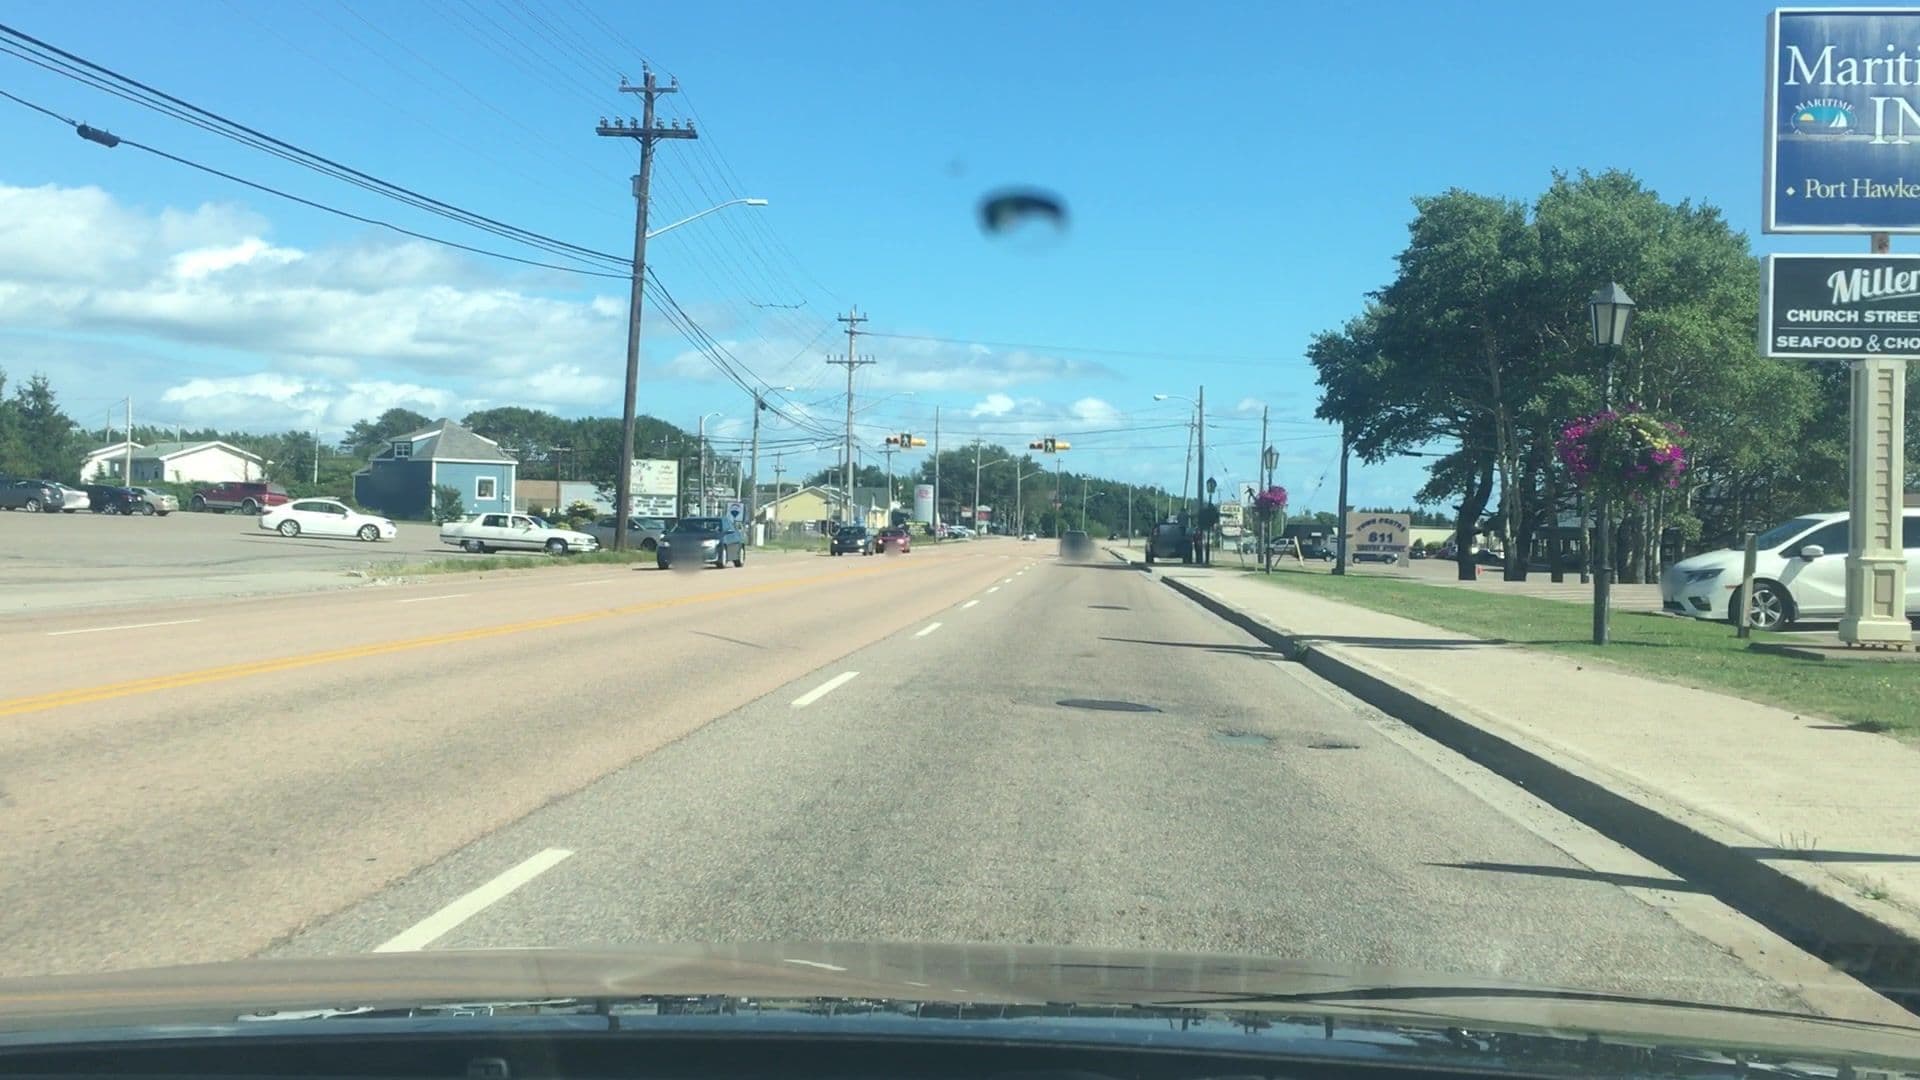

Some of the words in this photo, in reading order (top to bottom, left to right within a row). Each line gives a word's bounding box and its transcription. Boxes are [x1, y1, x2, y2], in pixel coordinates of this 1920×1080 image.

[1795, 98, 1855, 112] MARITIME
[1805, 179, 1847, 199] Port
[1853, 177, 1920, 199] Hawke
[1827, 267, 1920, 305] Miller
[1786, 309, 1859, 323] CHURCH
[1864, 310, 1920, 323] STREE
[1776, 335, 1863, 349] SEAFOOD
[1866, 334, 1881, 352] &
[1883, 337, 1920, 350] CHO
[1368, 532, 1393, 542] 611
